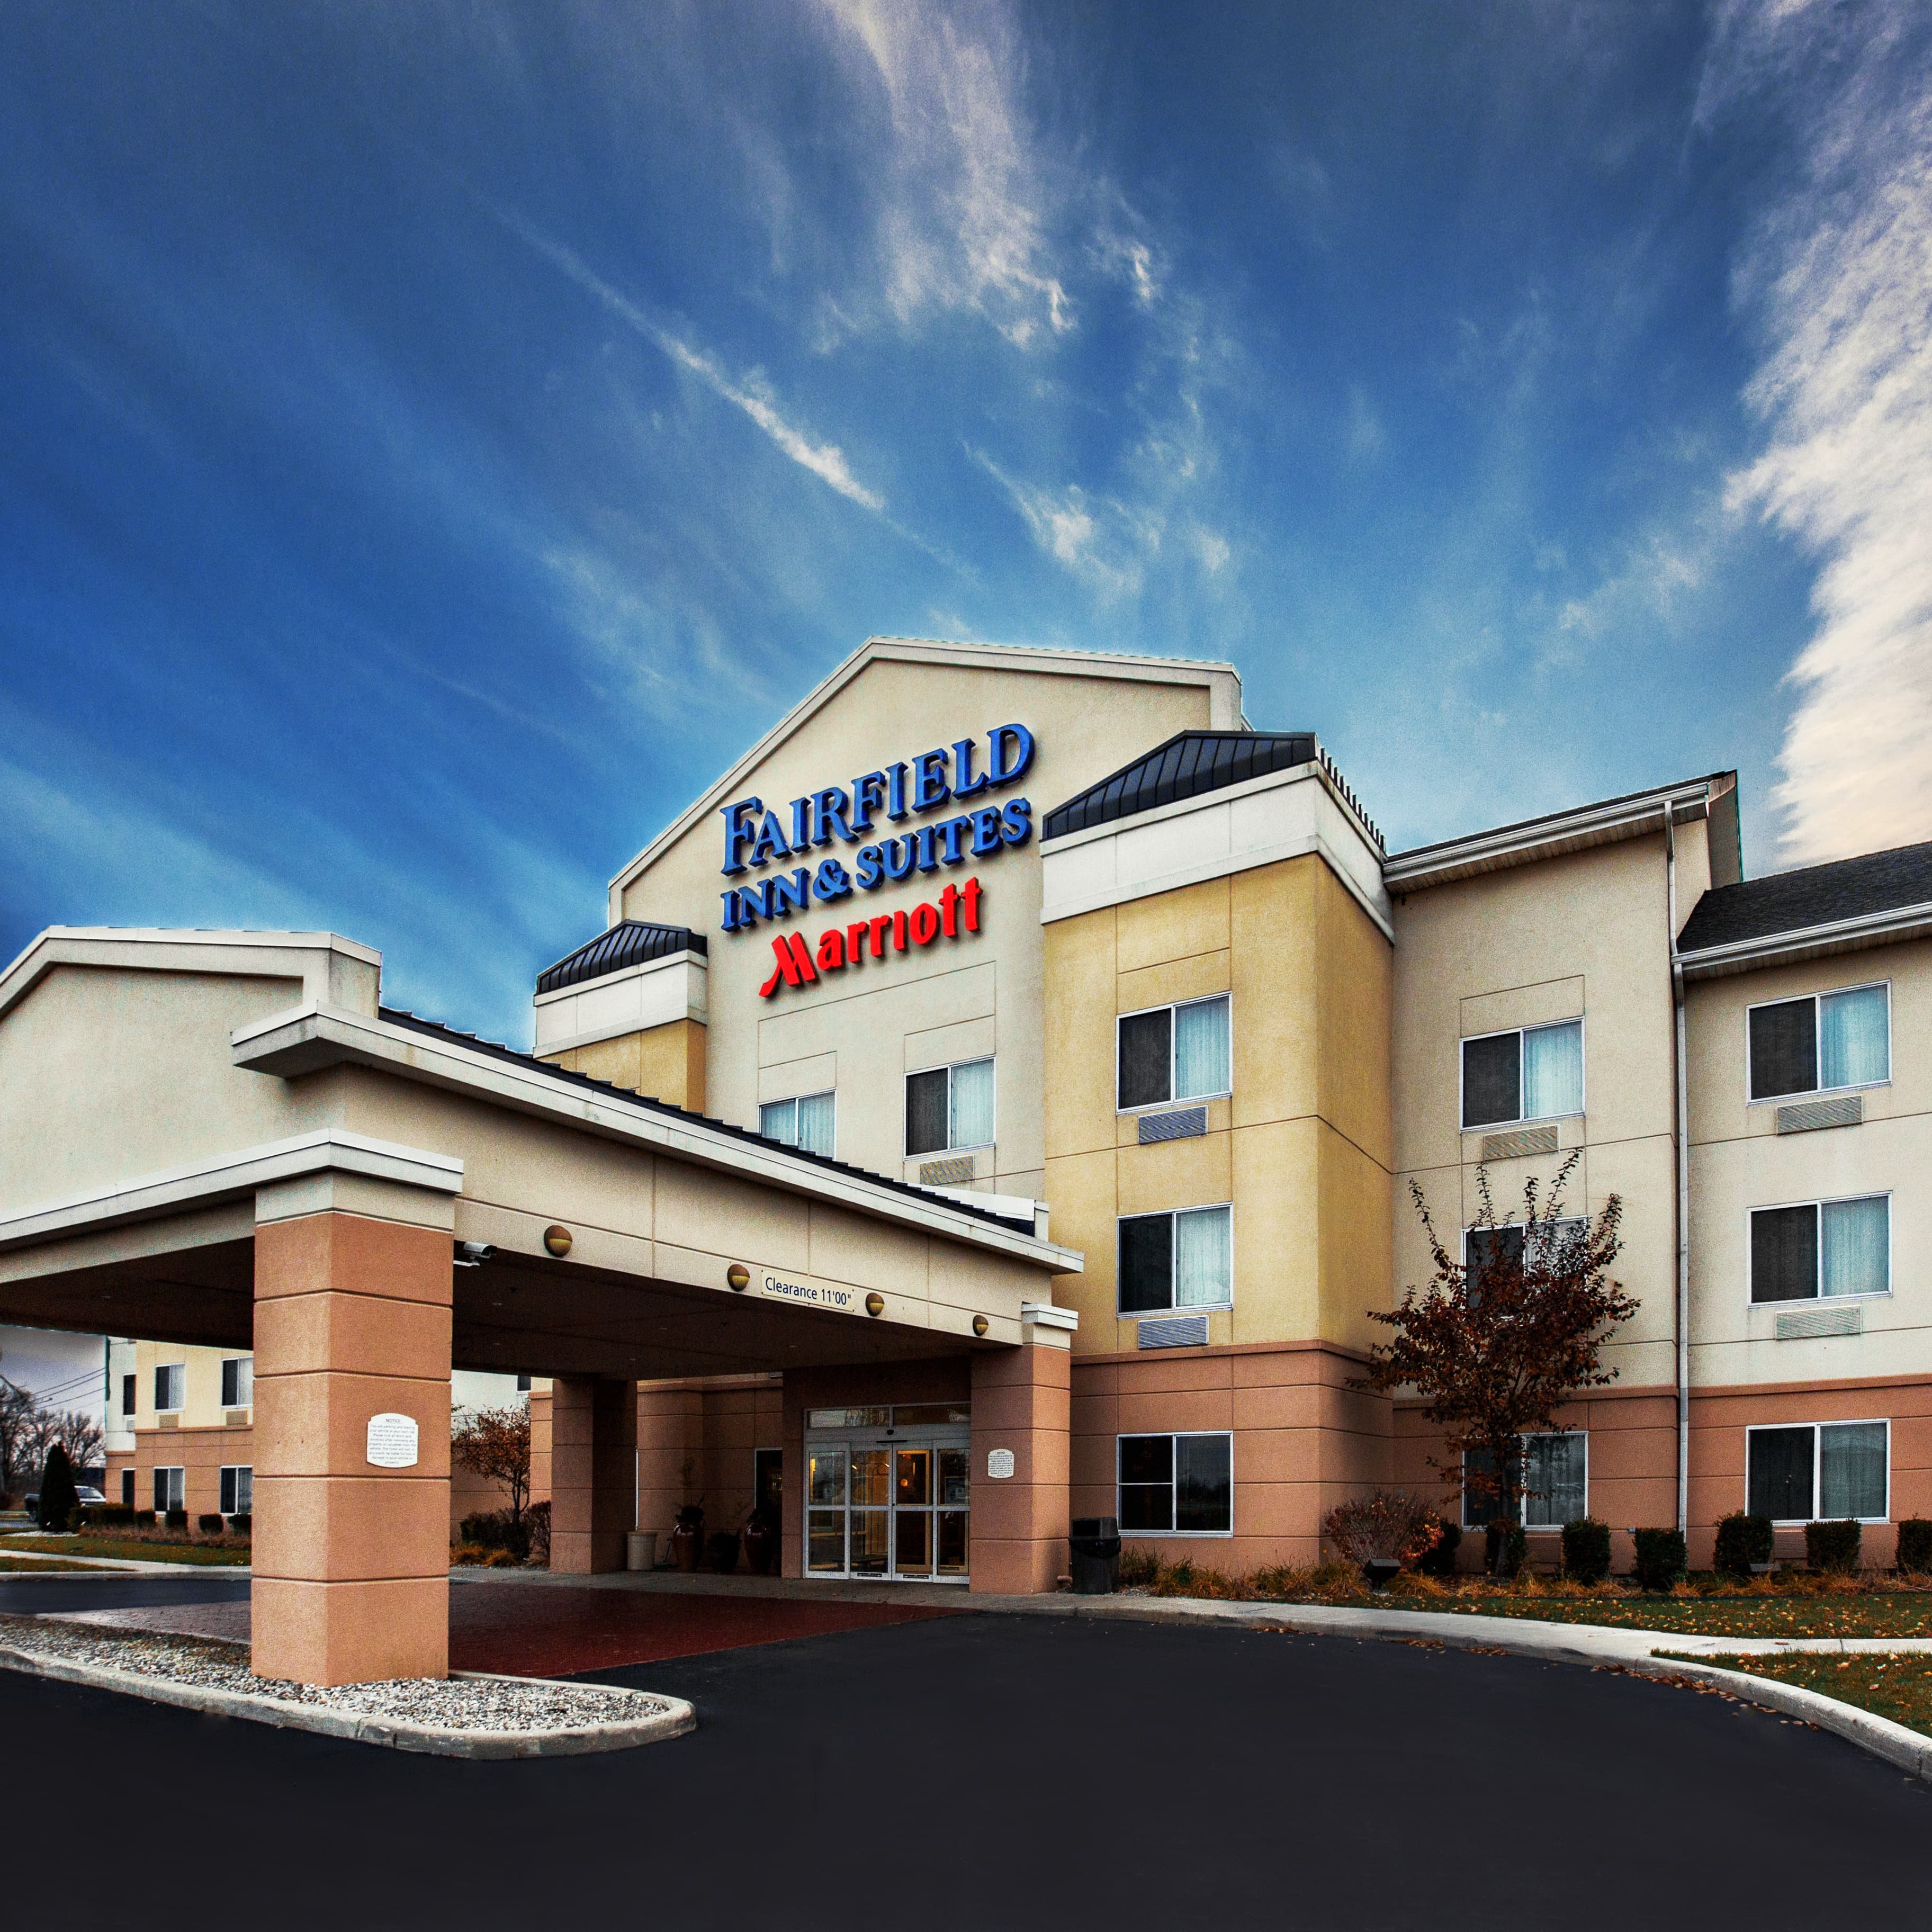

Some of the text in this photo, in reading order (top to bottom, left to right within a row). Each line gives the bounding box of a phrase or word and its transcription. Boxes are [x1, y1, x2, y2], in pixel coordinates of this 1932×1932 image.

[720, 723, 1035, 877] FAIRFIELD
[856, 797, 1032, 891] SUITES
[759, 876, 984, 998] Marriott
[765, 1277, 817, 1300] Clearance
